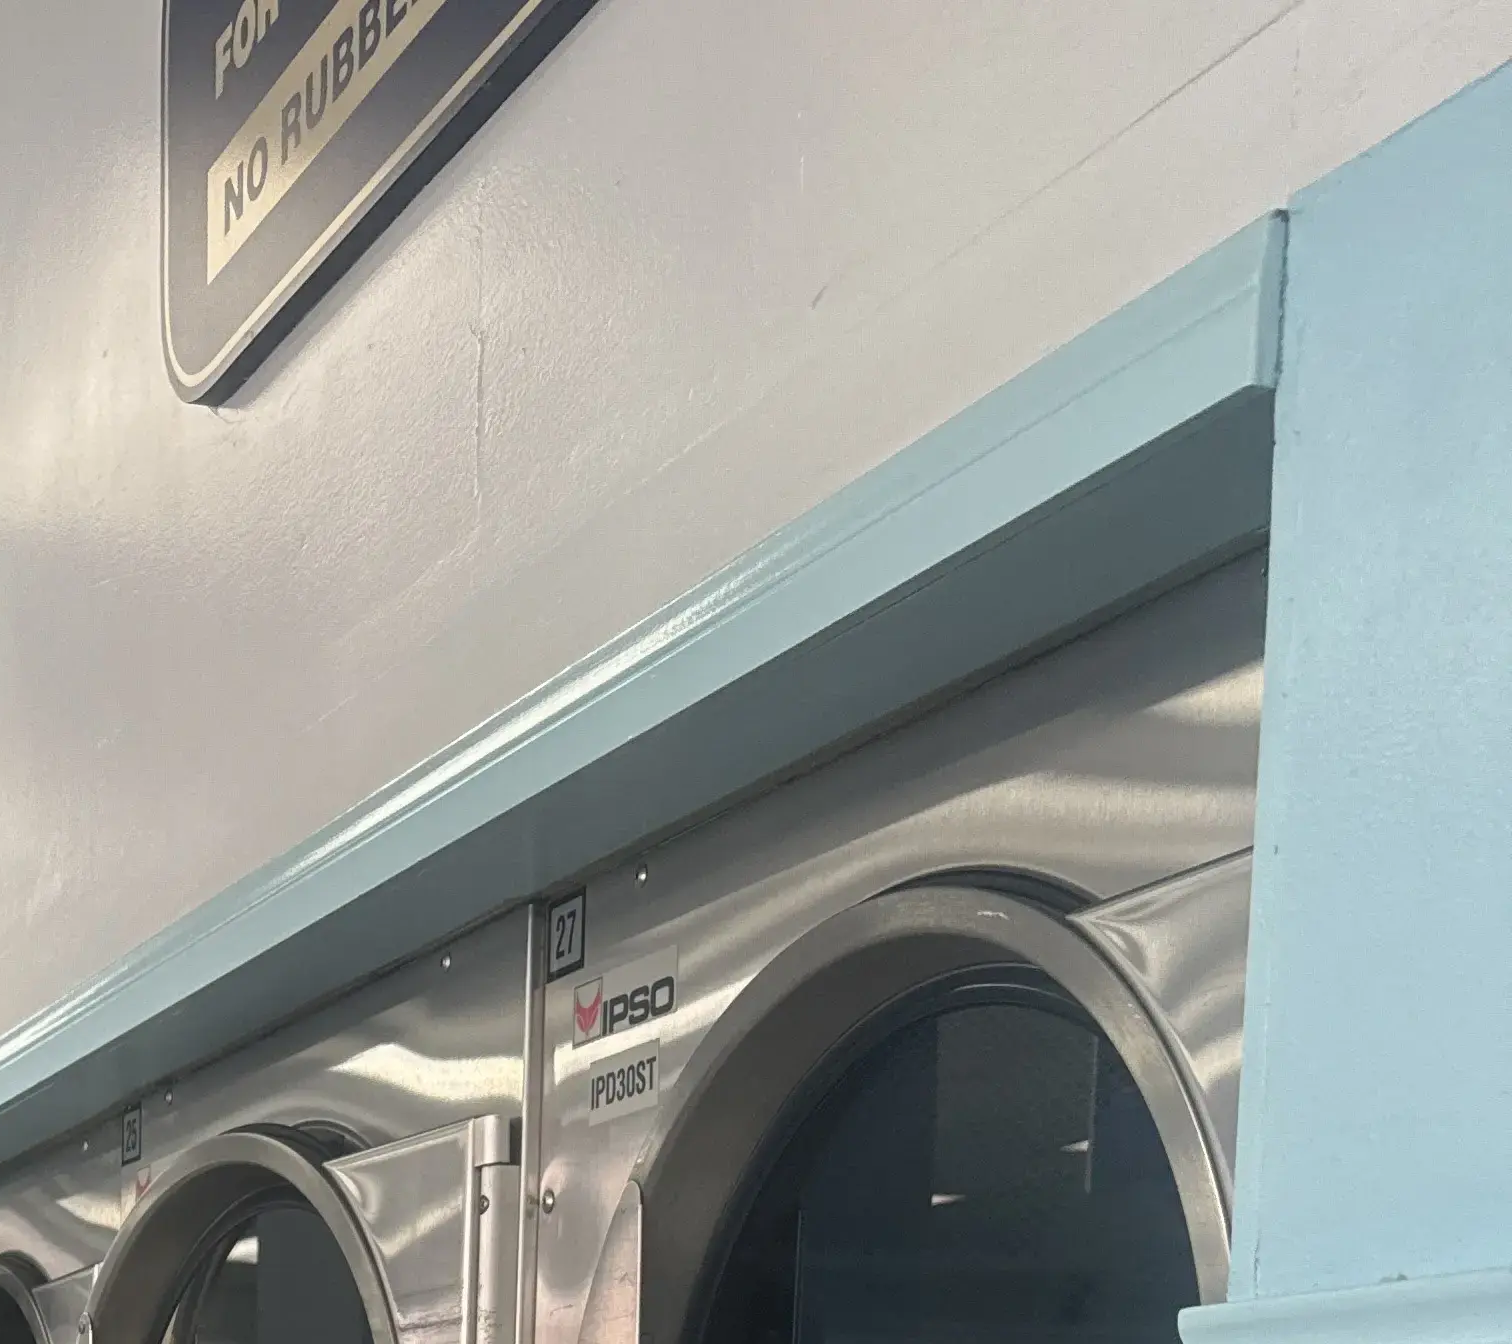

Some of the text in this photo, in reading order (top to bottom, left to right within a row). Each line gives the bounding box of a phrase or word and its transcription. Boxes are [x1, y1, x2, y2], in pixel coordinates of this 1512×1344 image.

[224, 136, 268, 237] NO
[555, 908, 577, 961] 27
[602, 976, 675, 1036] IPSO
[591, 1056, 657, 1110] IPD30ST
